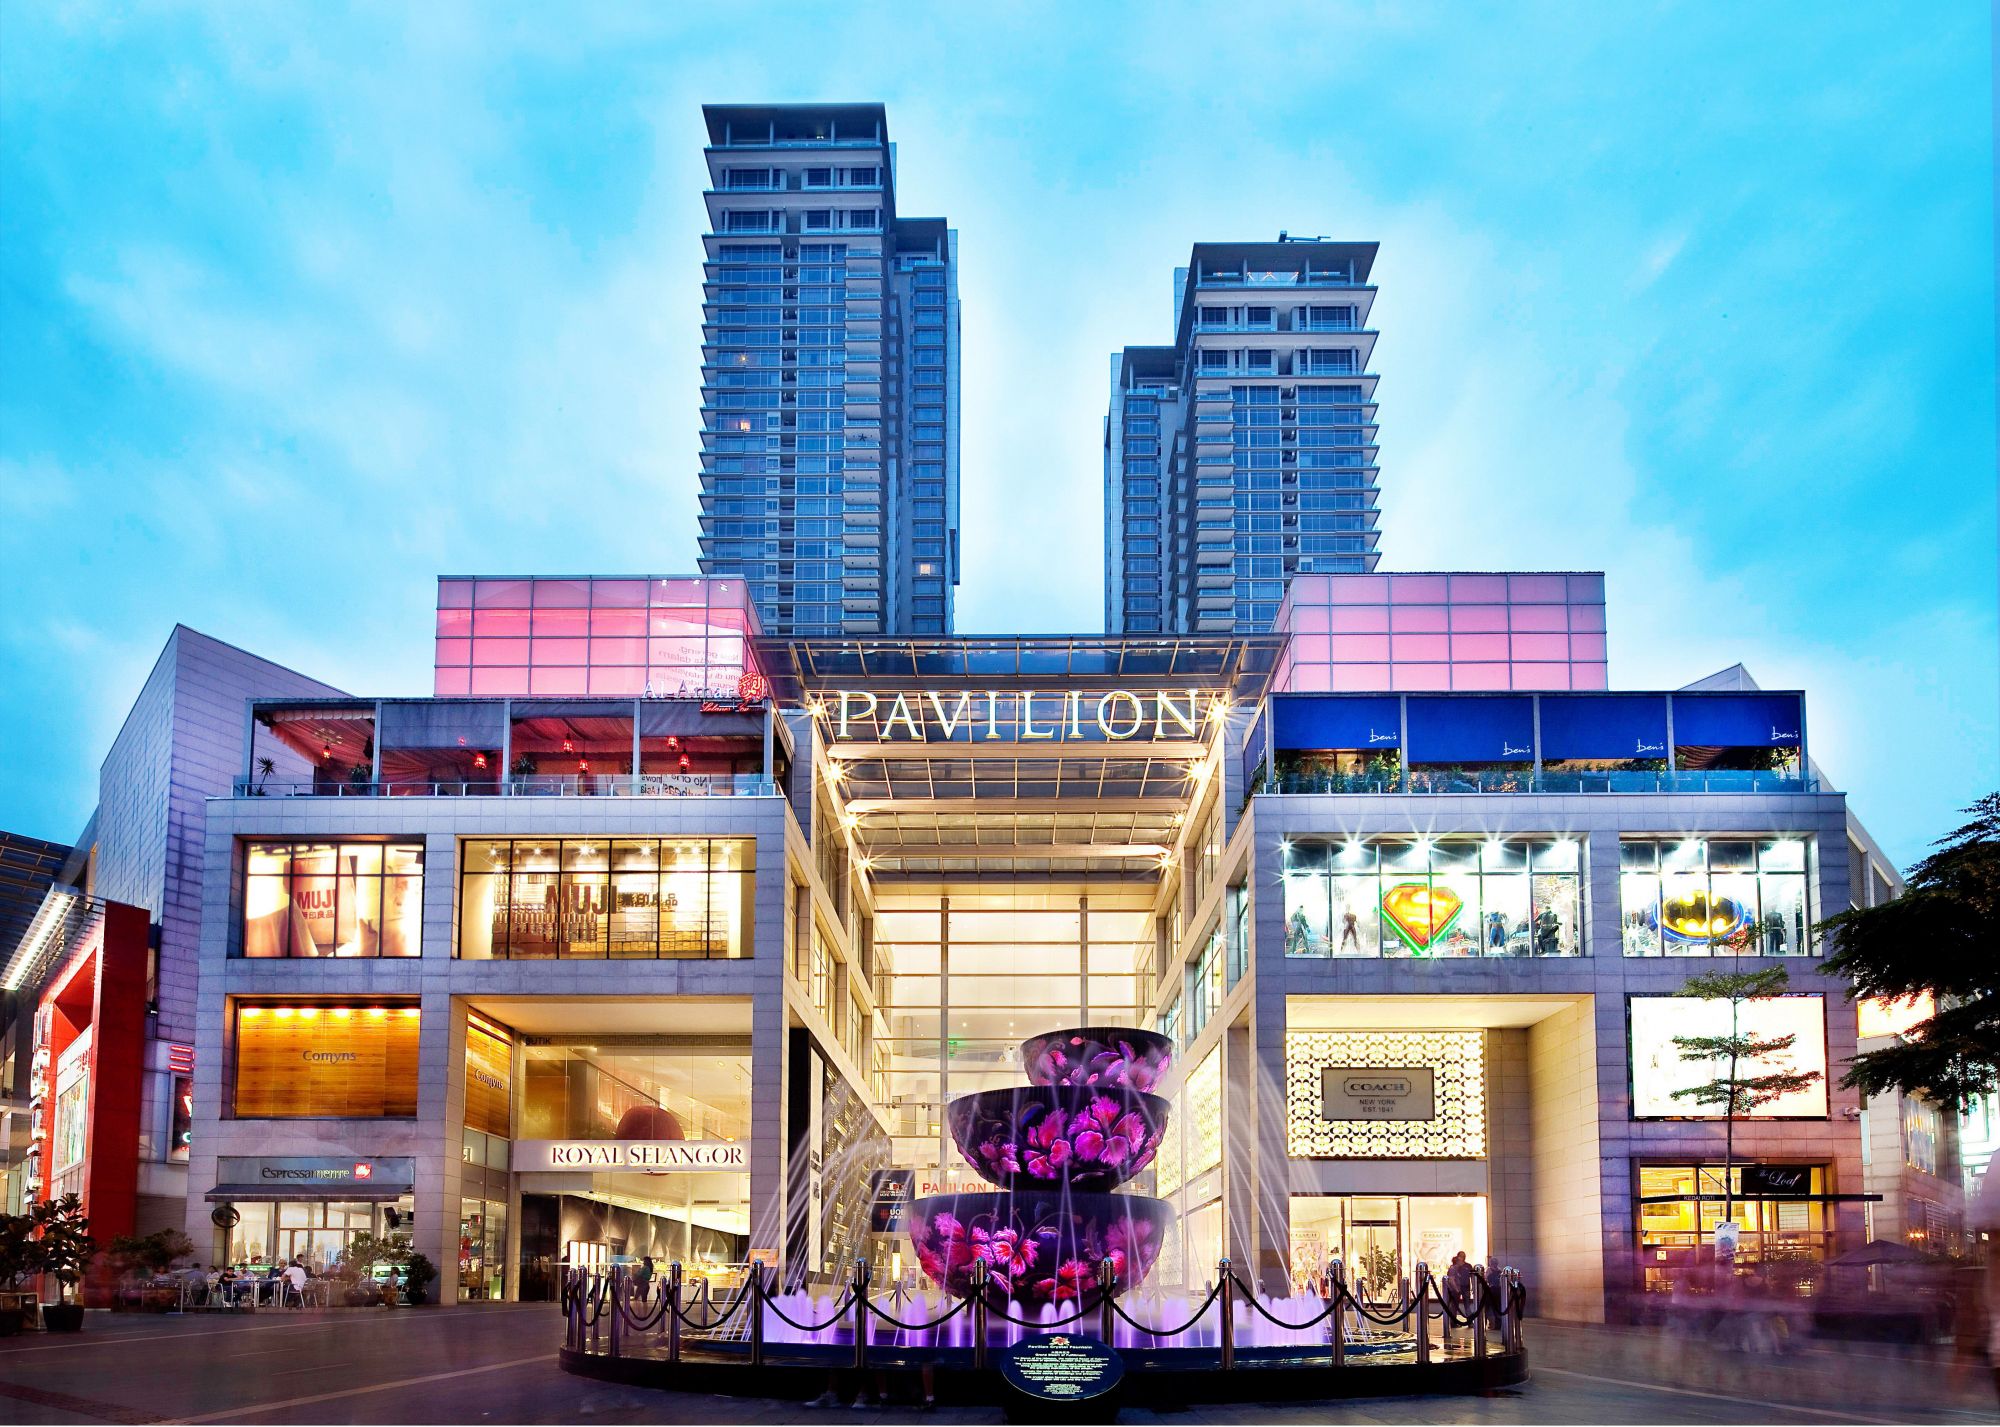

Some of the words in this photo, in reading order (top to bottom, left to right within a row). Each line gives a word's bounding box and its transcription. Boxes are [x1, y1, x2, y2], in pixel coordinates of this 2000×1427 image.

[642, 679, 735, 698] Al-Amar
[836, 689, 1199, 740] PAVILION
[297, 889, 336, 909] MUJI
[546, 885, 617, 914] MUJI
[303, 1050, 356, 1064] Comyns
[475, 1069, 504, 1090] Comyns
[1350, 1083, 1405, 1091] COACH
[552, 1147, 623, 1164] ROYAL
[630, 1147, 744, 1164] SELANGOR
[1757, 1169, 1768, 1177] The
[1767, 1170, 1802, 1187] Loaf
[922, 1183, 987, 1194] PAVILION
